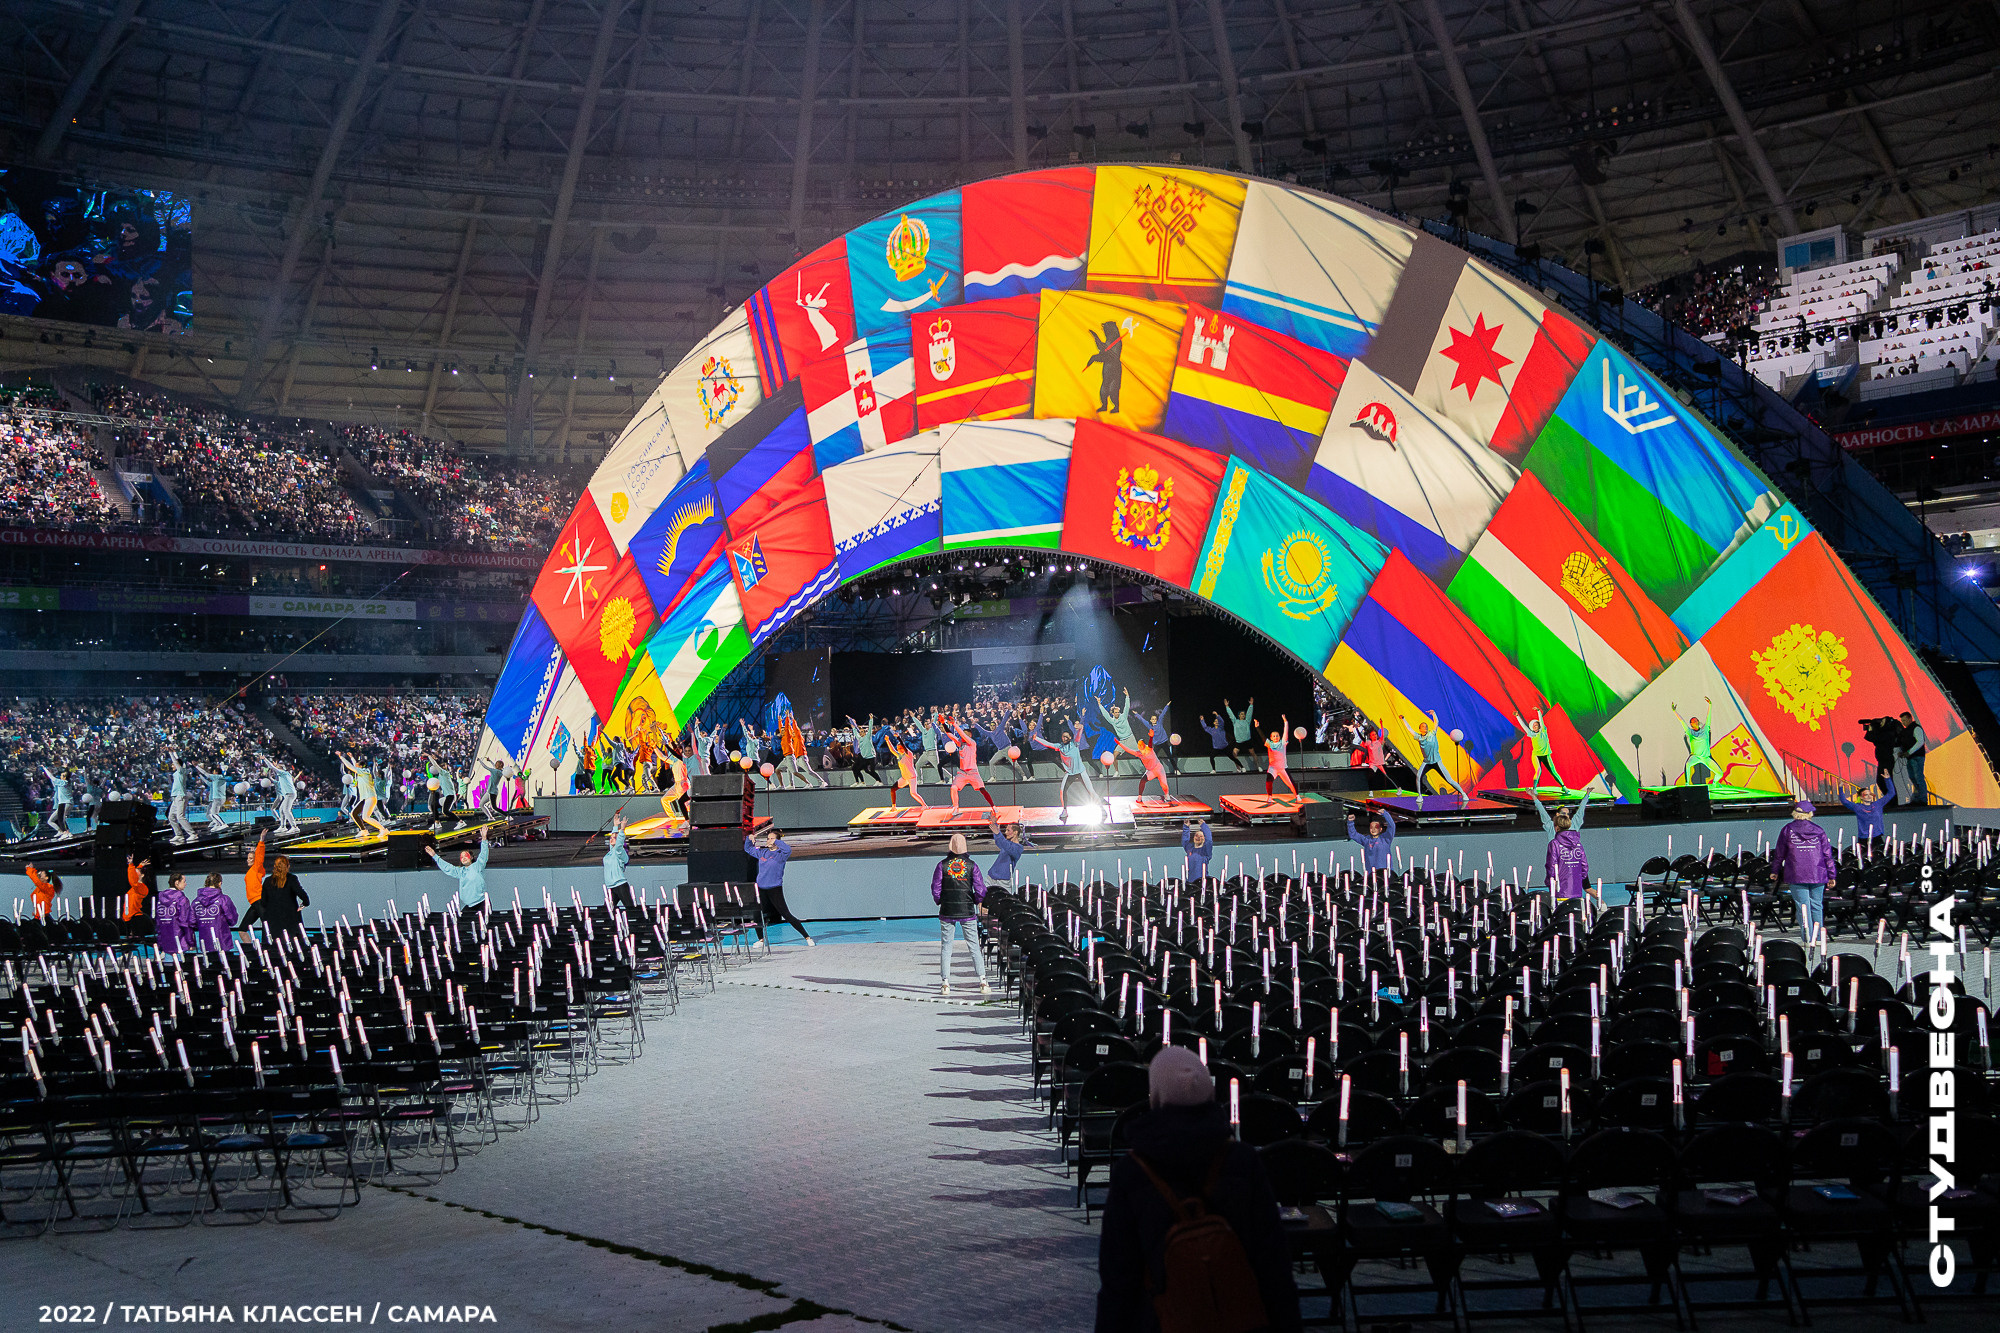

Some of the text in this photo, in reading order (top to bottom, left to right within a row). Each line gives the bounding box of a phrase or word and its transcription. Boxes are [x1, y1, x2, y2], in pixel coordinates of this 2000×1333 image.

[33, 531, 96, 547] САМАРА
[100, 536, 146, 549] АРЕНА
[202, 540, 404, 561] СОЛИДАРНОСТЬ САМАРА АРЕНА
[450, 552, 539, 568] СОЛИДАРНОСТЬ
[282, 601, 357, 614] САМАРА
